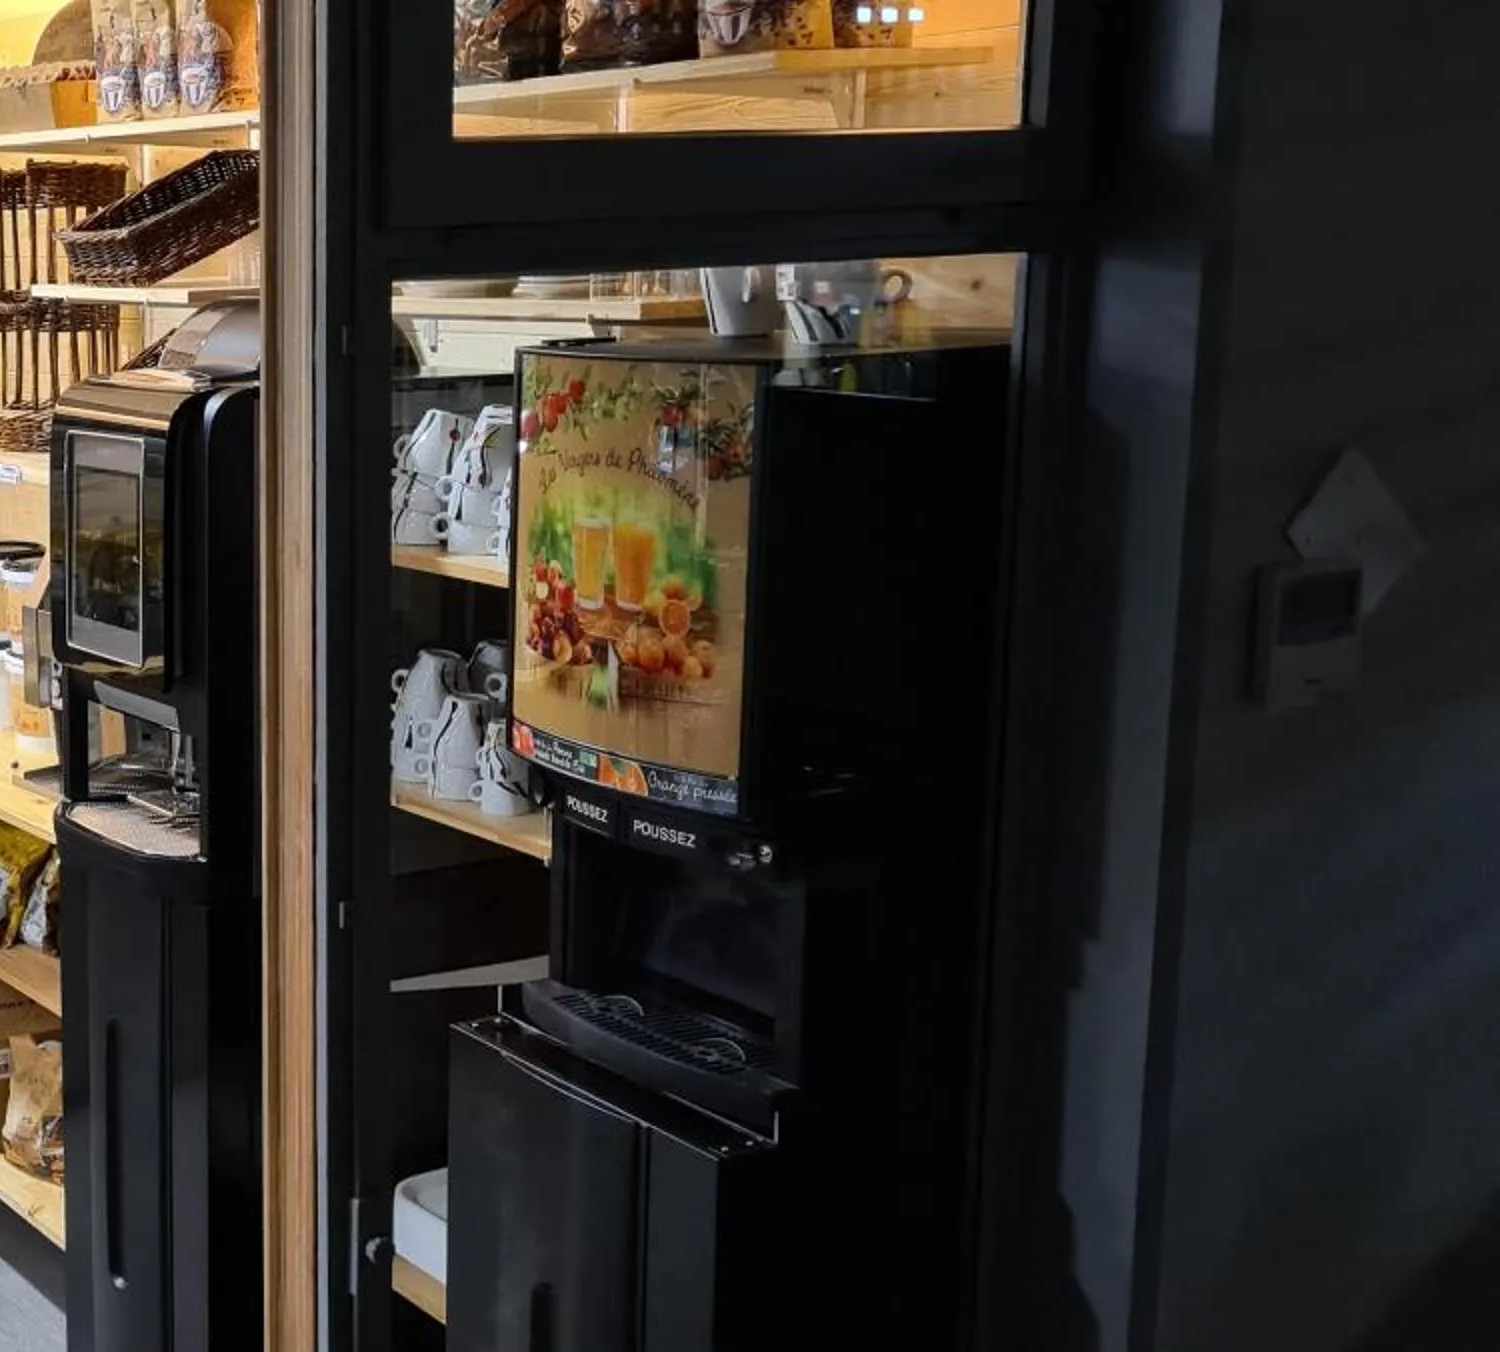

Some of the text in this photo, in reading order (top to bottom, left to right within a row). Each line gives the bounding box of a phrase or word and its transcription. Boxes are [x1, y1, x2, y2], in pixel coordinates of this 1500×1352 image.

[648, 770, 689, 801] Orange
[566, 795, 608, 823] POUSSEZ
[633, 819, 696, 849] POUSSEZ
